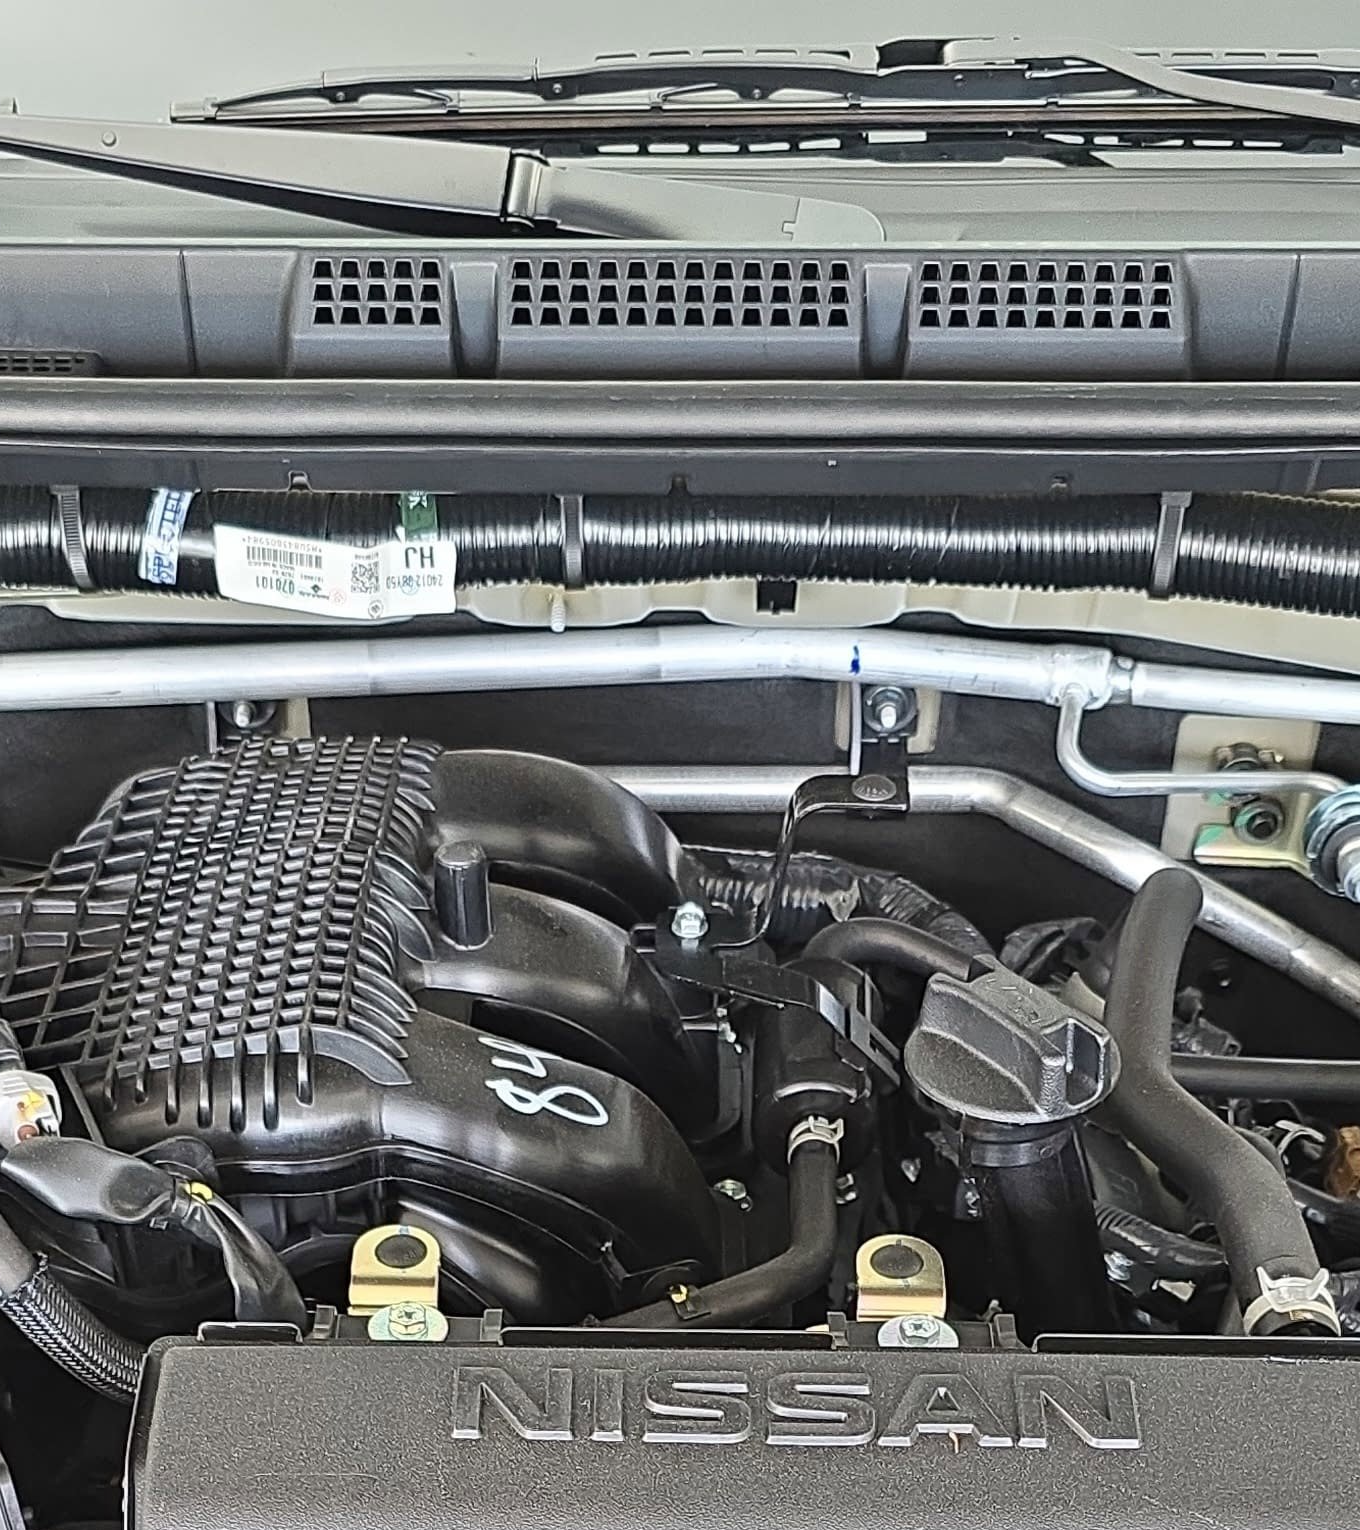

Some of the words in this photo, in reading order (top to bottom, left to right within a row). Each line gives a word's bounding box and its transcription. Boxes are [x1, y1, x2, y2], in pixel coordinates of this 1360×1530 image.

[405, 546, 435, 569] HJ
[415, 574, 444, 588] 24012
[478, 1036, 609, 1126] 84
[450, 1365, 1142, 1450] NISSAN
